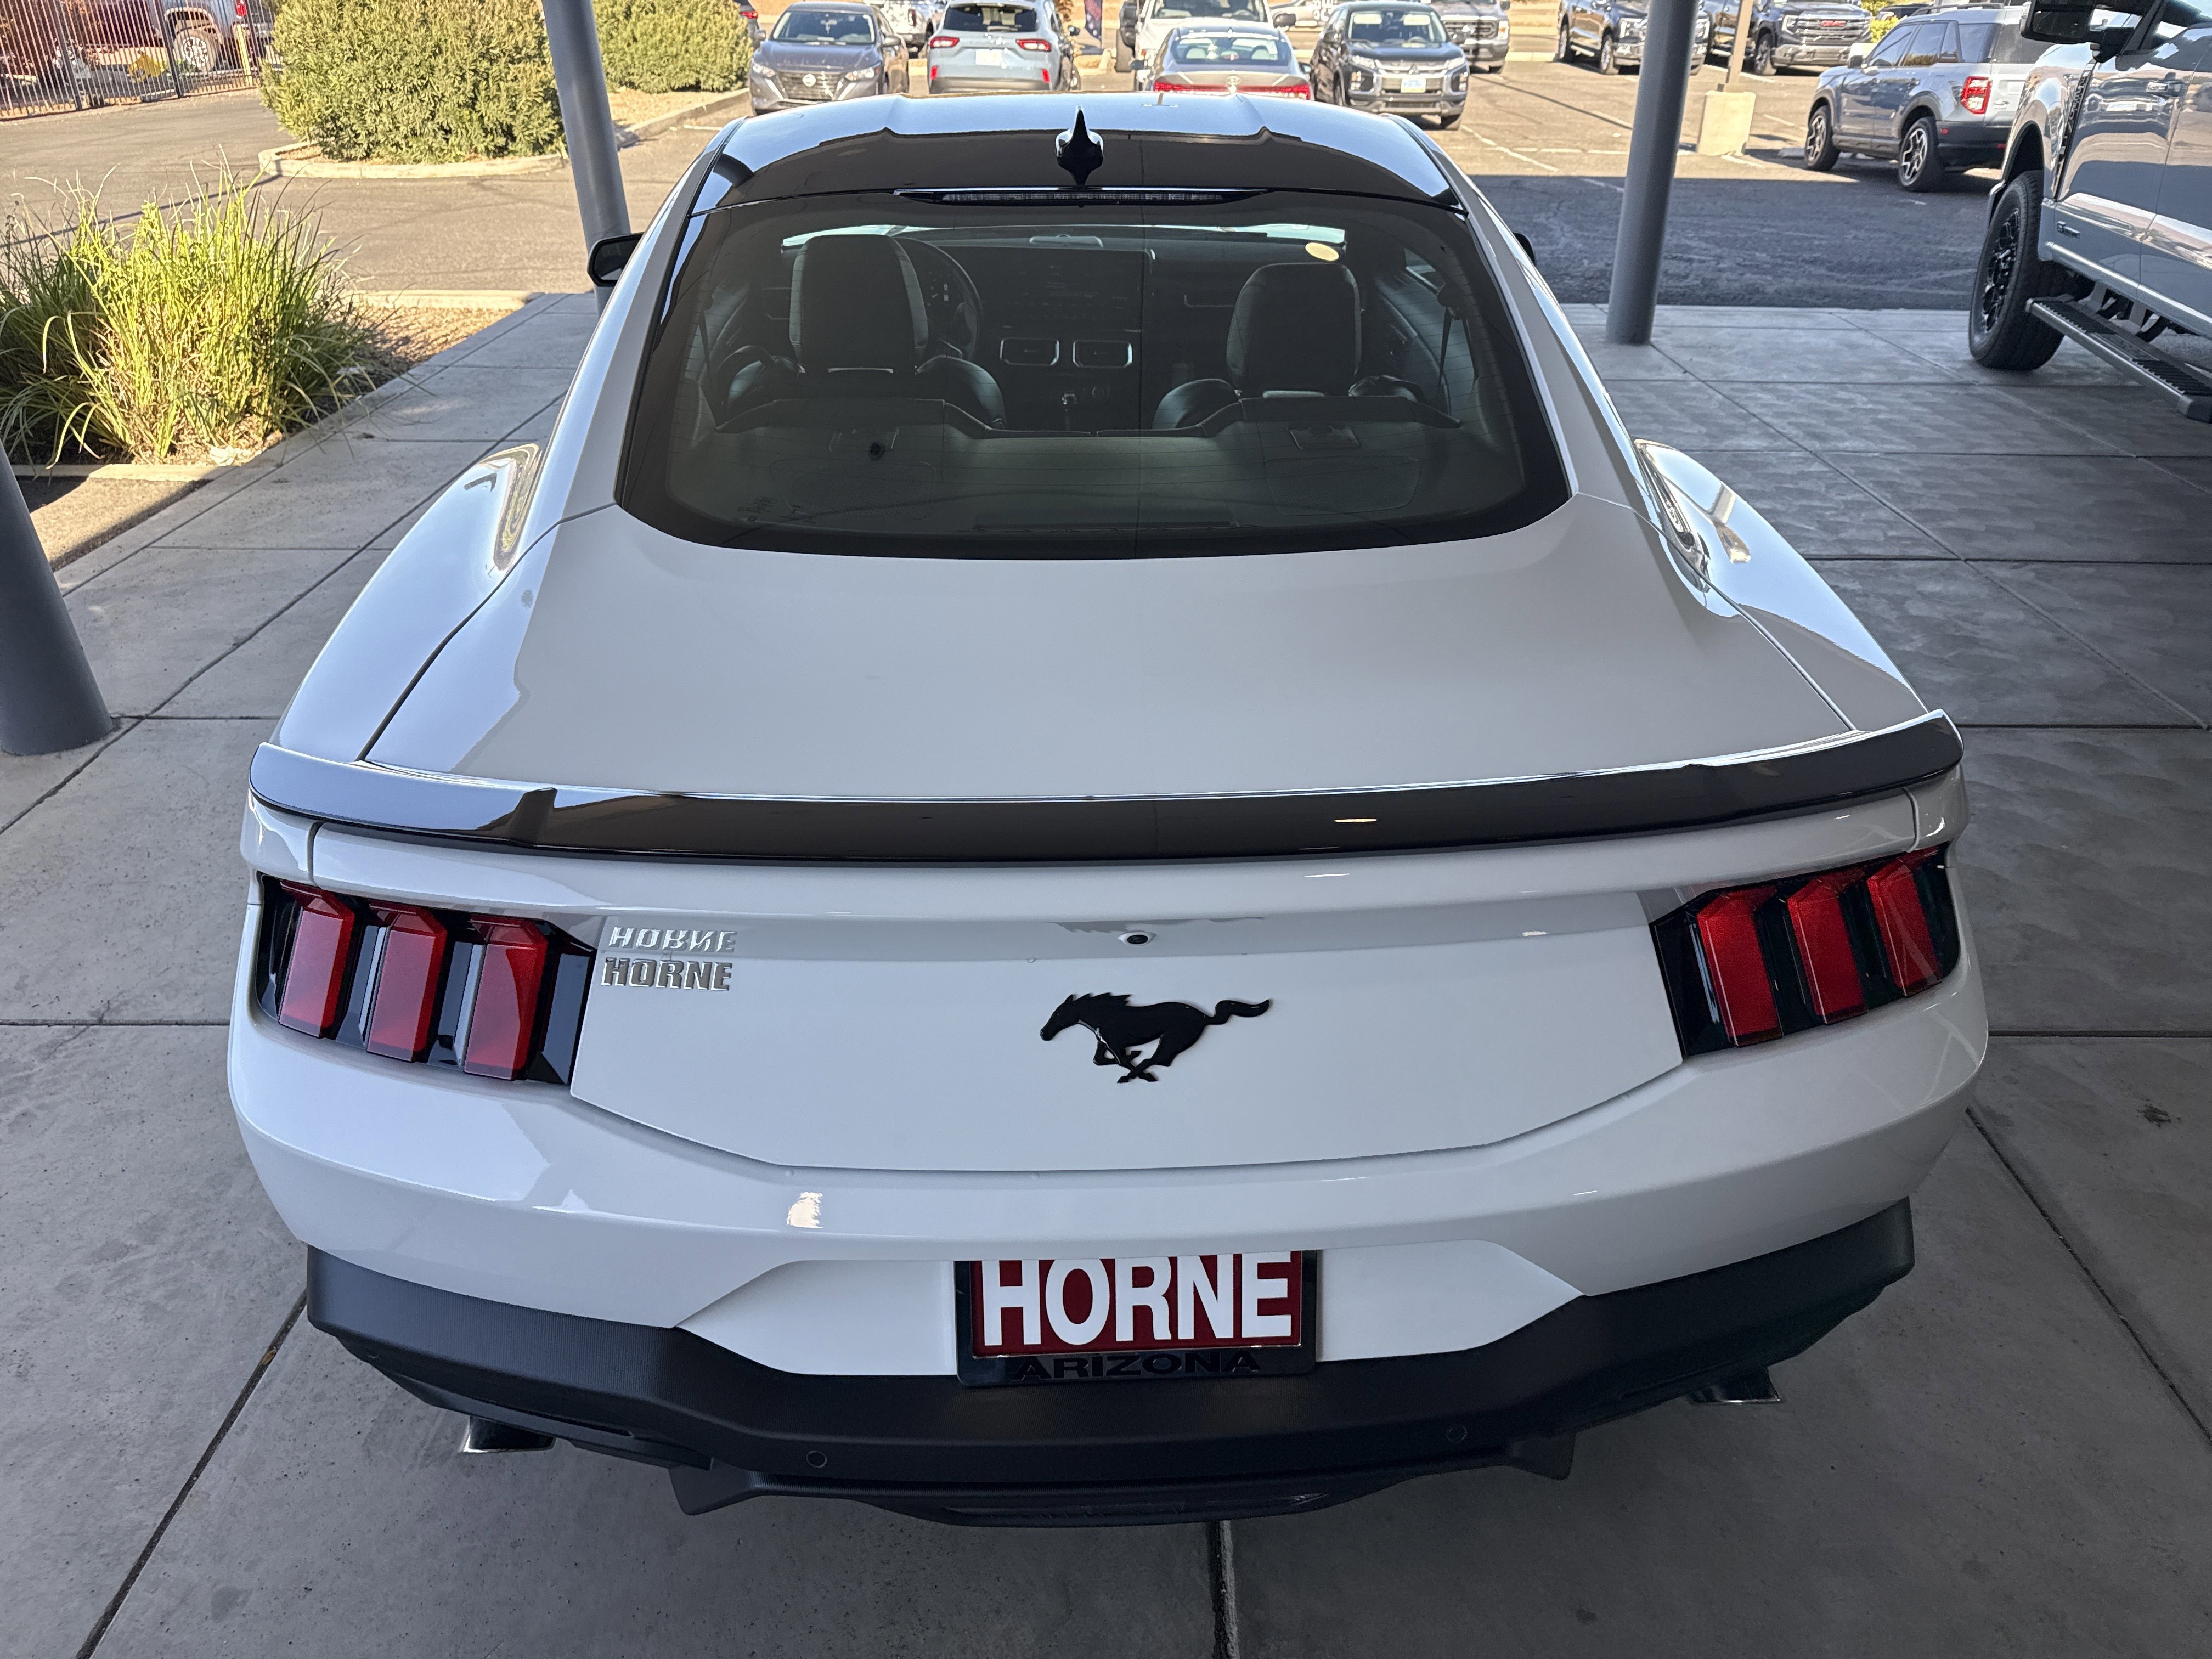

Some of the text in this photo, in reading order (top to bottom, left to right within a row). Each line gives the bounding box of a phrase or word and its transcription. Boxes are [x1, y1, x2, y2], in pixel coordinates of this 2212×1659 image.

[601, 957, 733, 991] HORNE
[981, 1251, 1291, 1346] HORNE
[1013, 1352, 1260, 1380] ARIZONA
